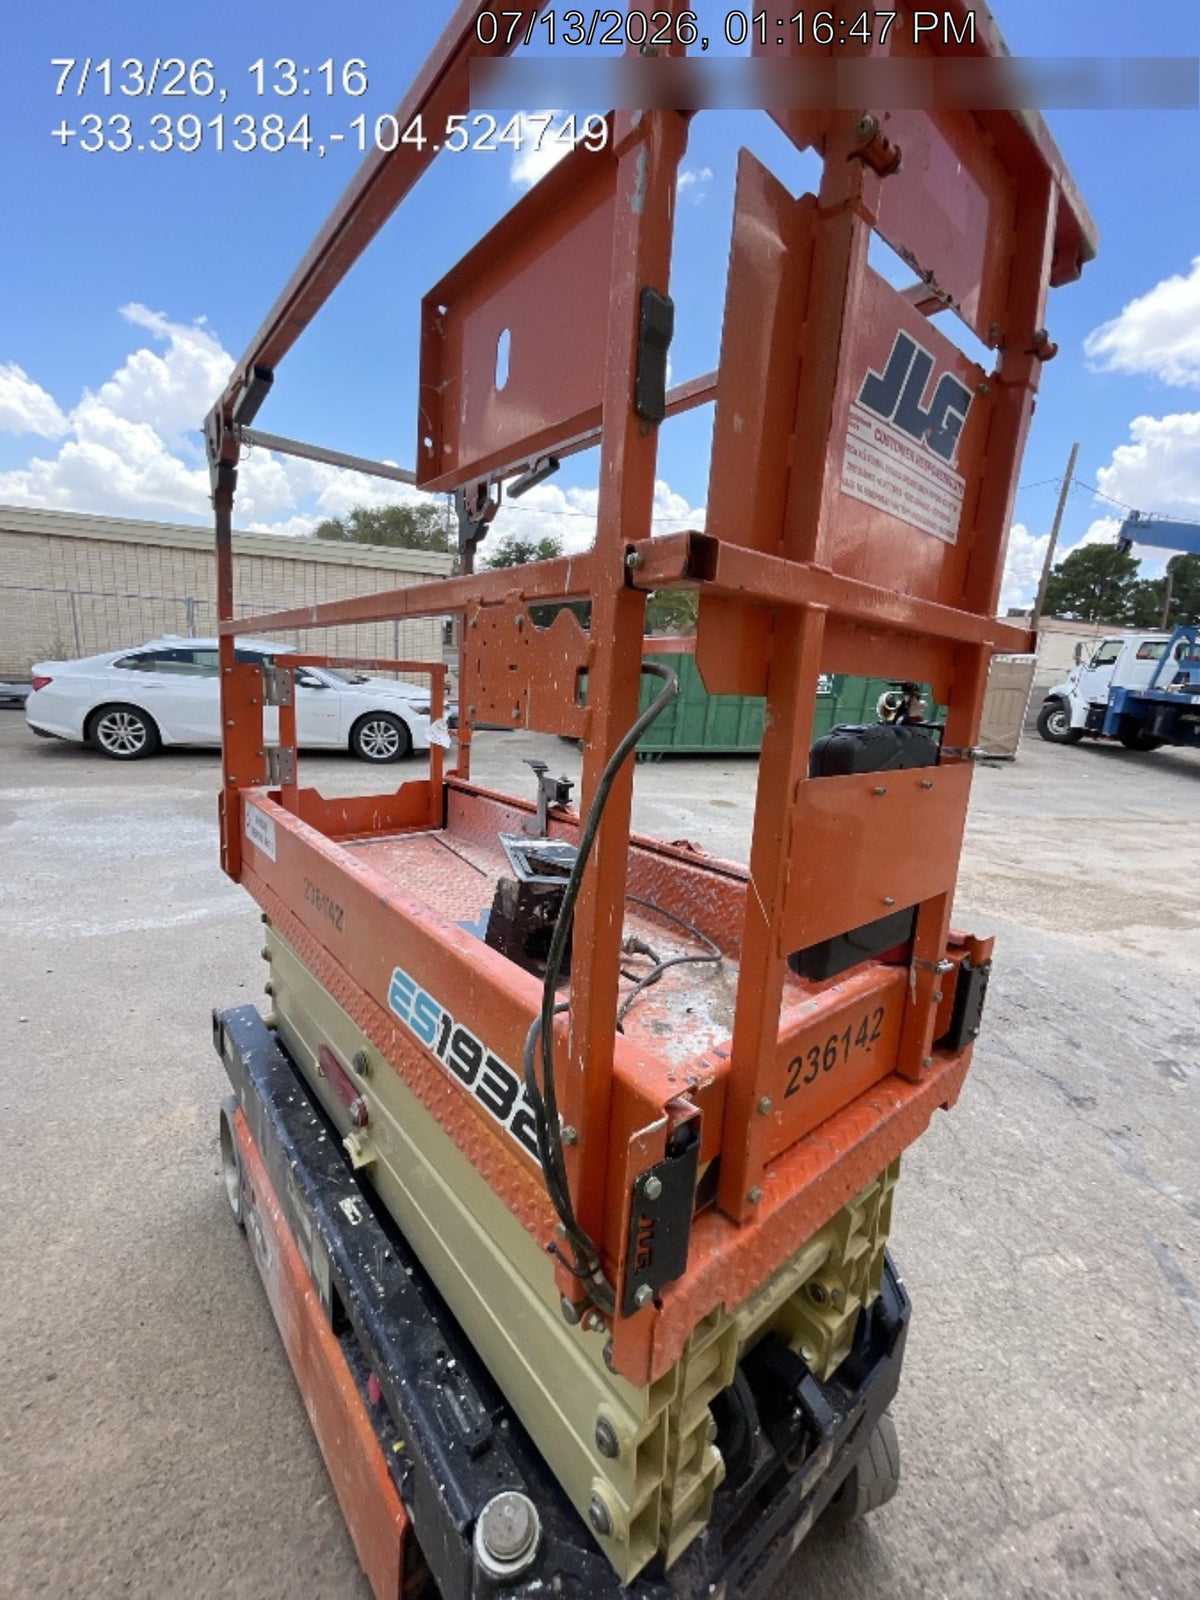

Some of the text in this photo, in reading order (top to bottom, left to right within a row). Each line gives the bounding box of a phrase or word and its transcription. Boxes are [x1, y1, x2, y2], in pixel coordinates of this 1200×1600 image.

[855, 329, 975, 462] JLG
[784, 1006, 885, 1099] 236142
[634, 1213, 656, 1276] JLG
